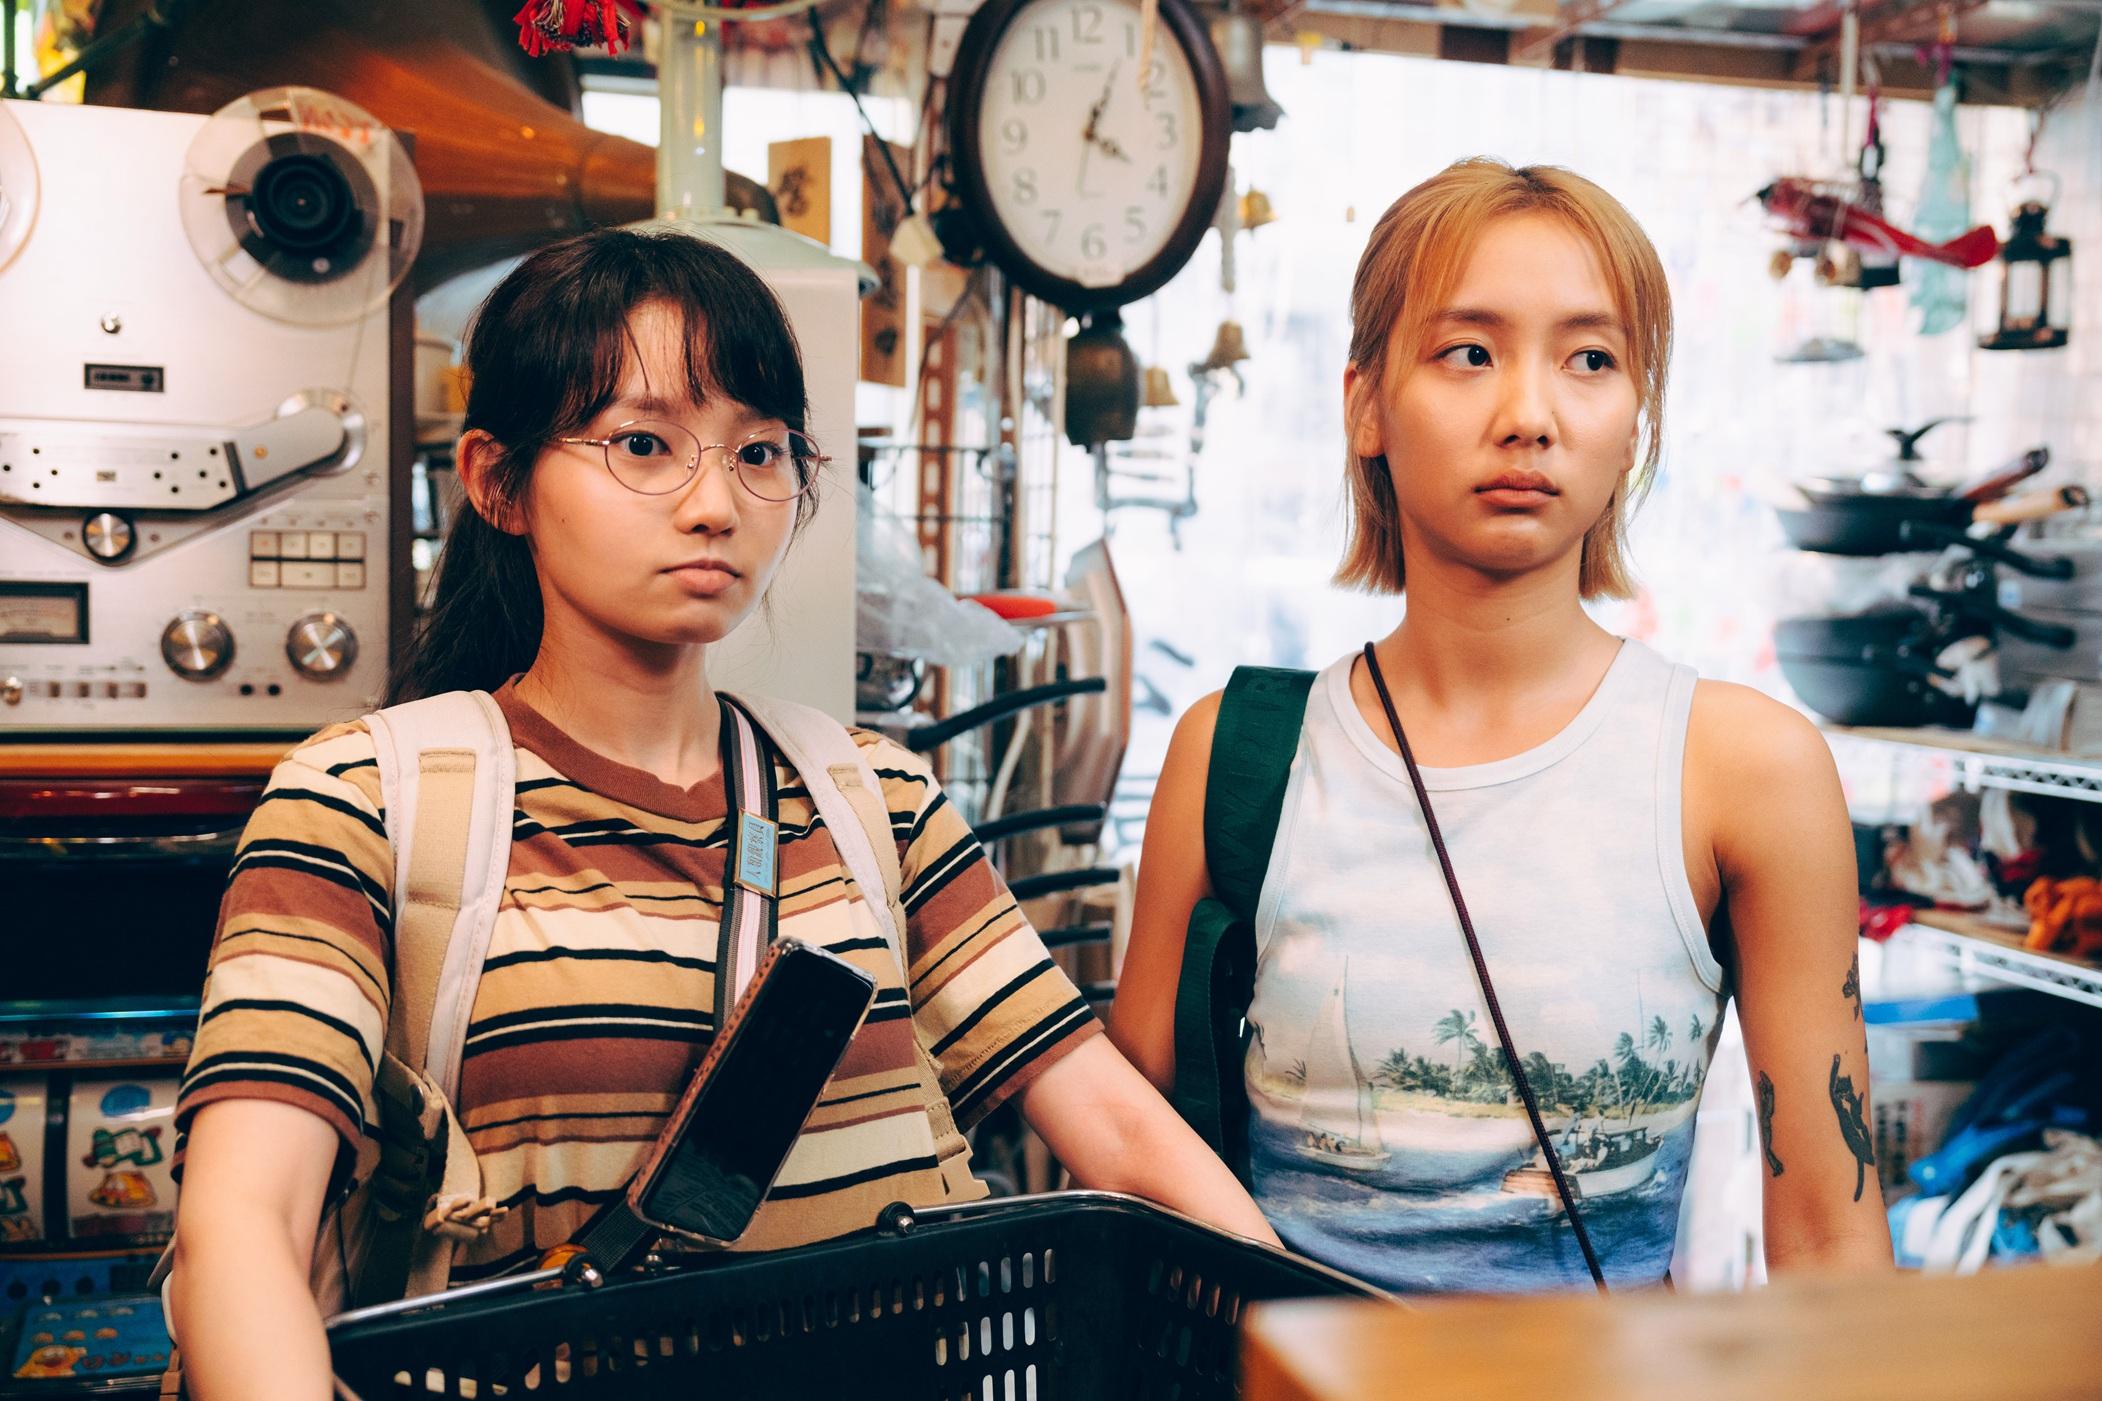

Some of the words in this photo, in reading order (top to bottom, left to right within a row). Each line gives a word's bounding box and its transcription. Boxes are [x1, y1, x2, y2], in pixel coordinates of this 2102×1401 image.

[1072, 7, 1103, 43] 12
[1126, 23, 1135, 56] 1
[1035, 26, 1060, 61] 11
[1011, 69, 1046, 104] 10
[1145, 60, 1166, 98] 2
[1002, 119, 1028, 154] 9
[1155, 112, 1177, 150] 3
[1012, 168, 1037, 204] 8
[1147, 165, 1169, 197] 4
[1041, 209, 1063, 244] 7
[1081, 224, 1106, 259] 6
[1125, 206, 1147, 243] 5
